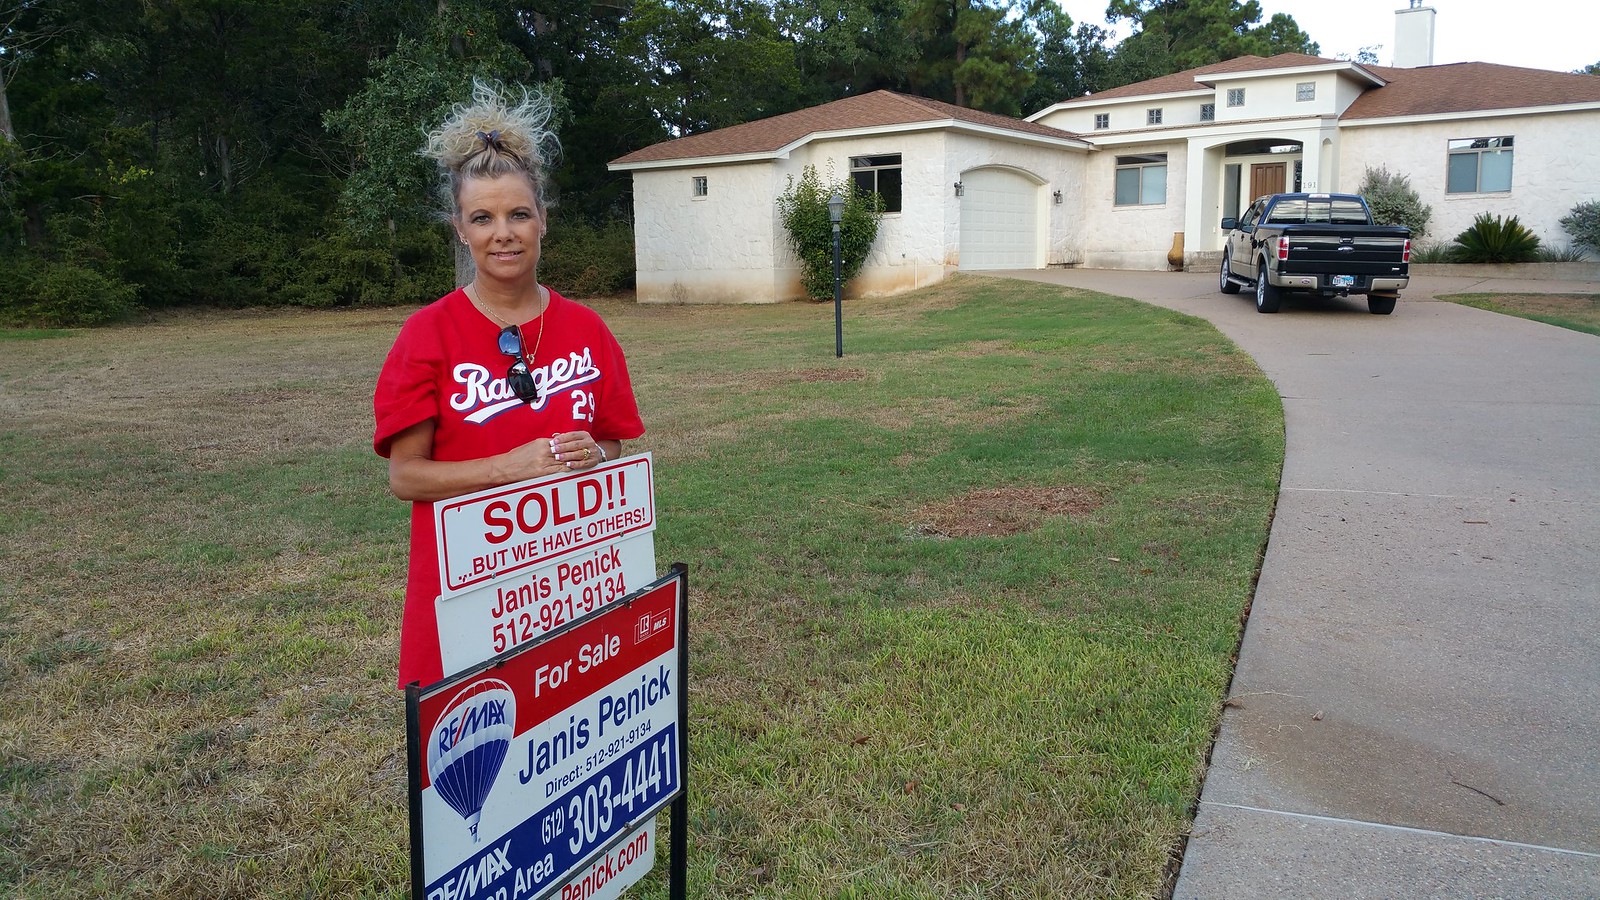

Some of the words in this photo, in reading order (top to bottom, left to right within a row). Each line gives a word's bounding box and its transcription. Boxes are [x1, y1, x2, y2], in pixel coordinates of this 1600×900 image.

[1302, 181, 1317, 189] 191
[450, 347, 600, 412] Ragers
[571, 390, 595, 423] 29
[483, 471, 627, 544] SOLD!!
[512, 540, 538, 563] WE
[543, 527, 583, 553] HAVE
[587, 507, 645, 538] OTHERS!
[492, 575, 550, 618] Janis
[557, 545, 622, 592] Penick
[492, 572, 626, 653] 512-921-9134
[653, 617, 667, 631] MLS
[534, 659, 572, 698] For
[578, 634, 620, 674] Sale
[439, 699, 506, 757] RE/MAX
[519, 715, 590, 785] Janis
[599, 664, 671, 738] Penick
[546, 765, 583, 798] Direct:
[586, 719, 651, 772] 512-921-9134
[541, 805, 565, 845] (512)
[568, 734, 672, 855] 303-4441
[513, 852, 554, 900] Area
